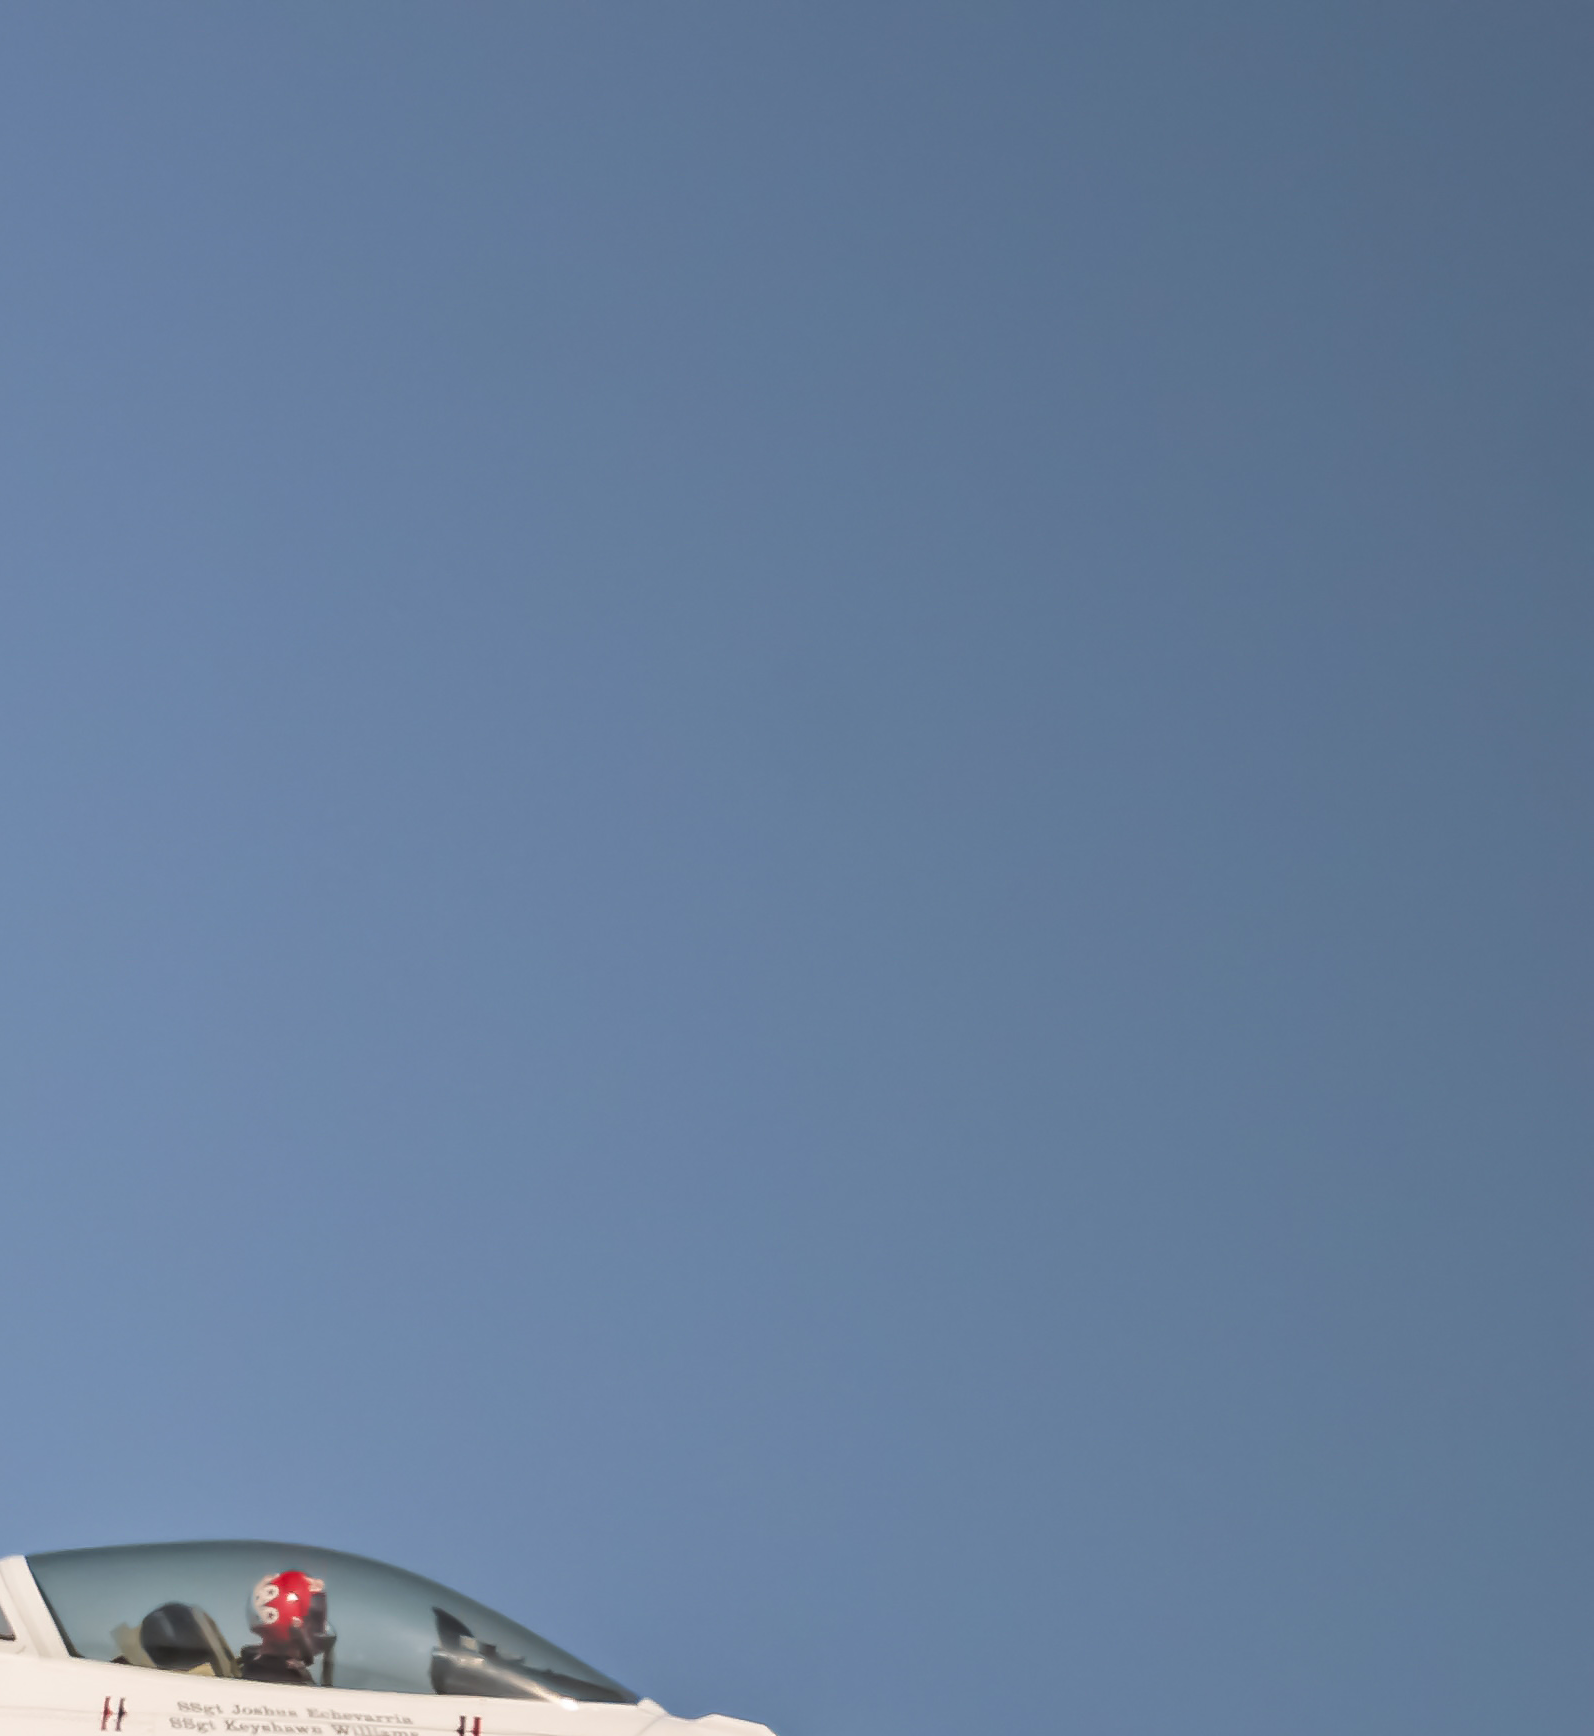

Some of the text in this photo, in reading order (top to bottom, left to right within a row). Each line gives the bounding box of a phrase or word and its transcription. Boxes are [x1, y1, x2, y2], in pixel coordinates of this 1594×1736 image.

[176, 1701, 414, 1725] SSgt Joshua Echevarria
[168, 1716, 217, 1733] SSgt
[224, 1719, 323, 1735] Keyshawn
